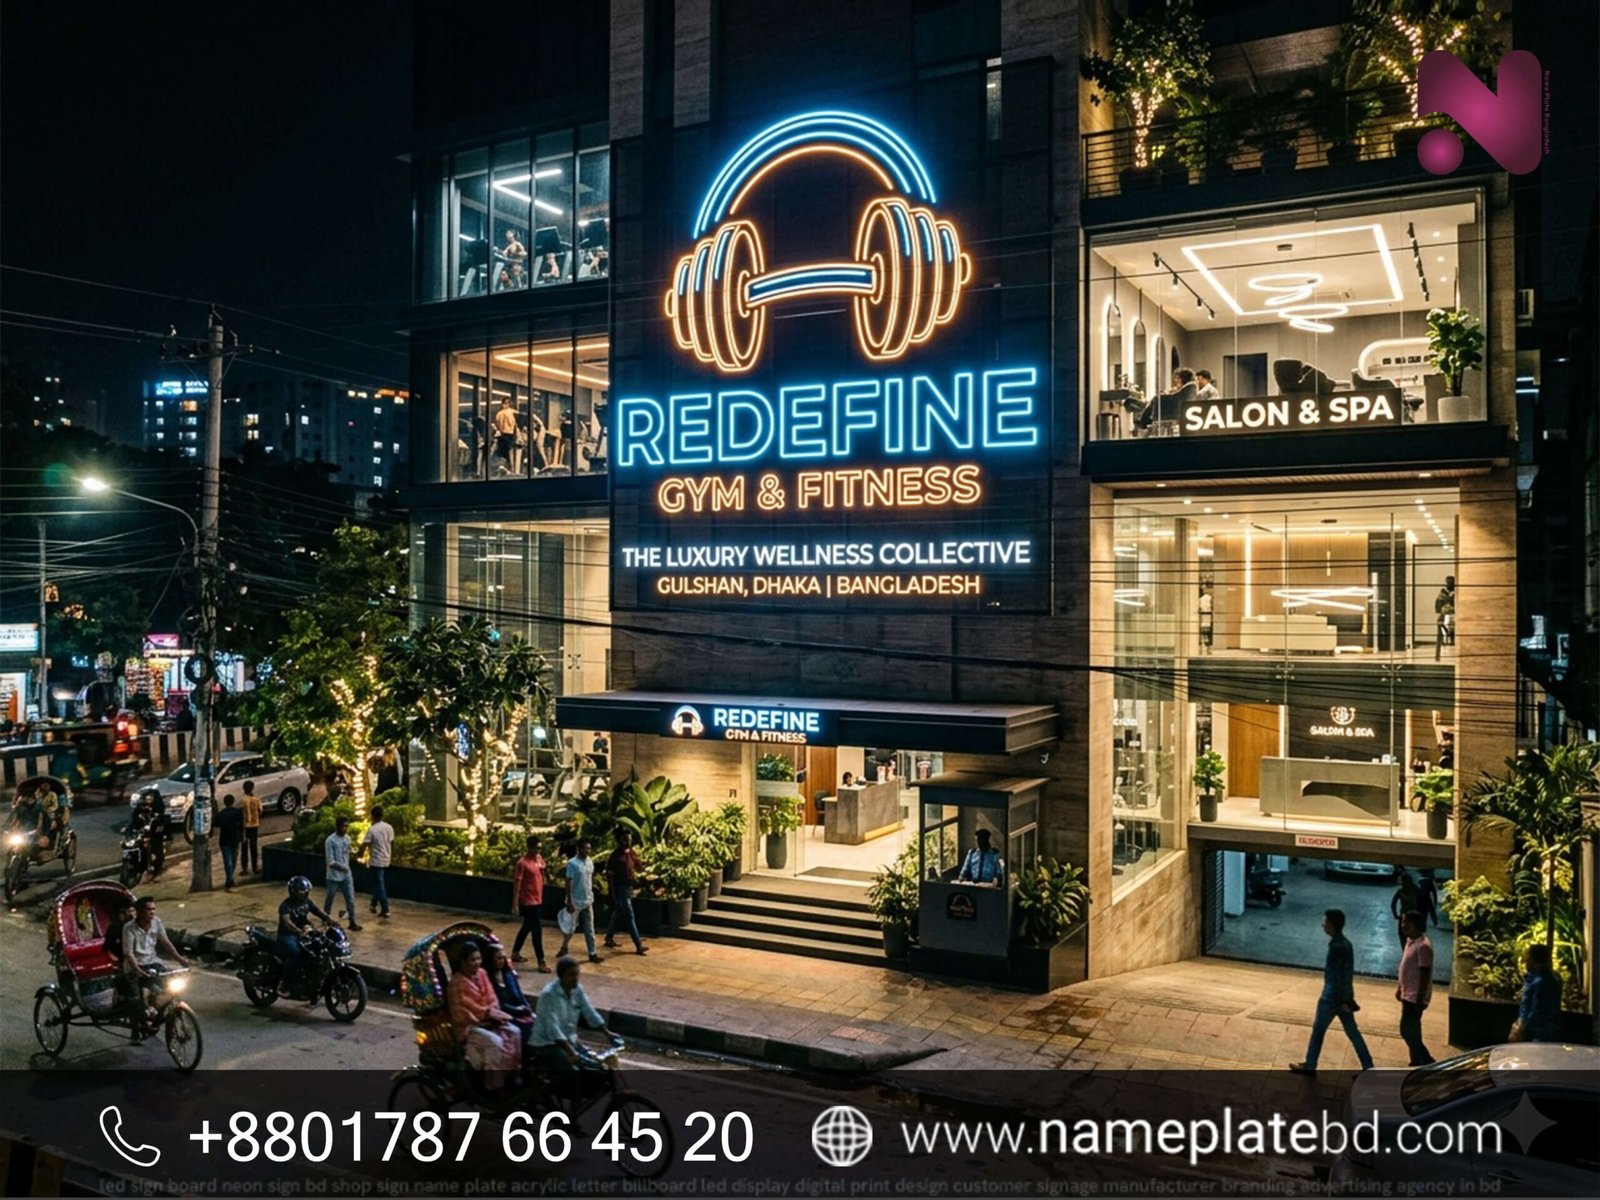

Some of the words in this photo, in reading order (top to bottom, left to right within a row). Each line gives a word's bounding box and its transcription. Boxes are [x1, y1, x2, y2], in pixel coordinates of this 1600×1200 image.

[617, 367, 1039, 466] REDEFINE
[1185, 401, 1290, 431] SALON
[1298, 399, 1320, 425] &
[1329, 395, 1395, 423] SPA
[658, 475, 745, 513] GYM
[757, 473, 785, 510] &
[798, 465, 981, 508] FITNESS
[622, 547, 662, 567] THE
[666, 546, 749, 567] LUXURY
[753, 543, 874, 566] WELLNESS
[879, 540, 1031, 565] COLLECTIVE
[657, 576, 748, 597] GULSHAN,
[753, 576, 821, 594] DHAKA
[837, 575, 981, 595] BANGLADESH
[713, 708, 820, 733] REDEFINE
[761, 731, 807, 744] FITNESS
